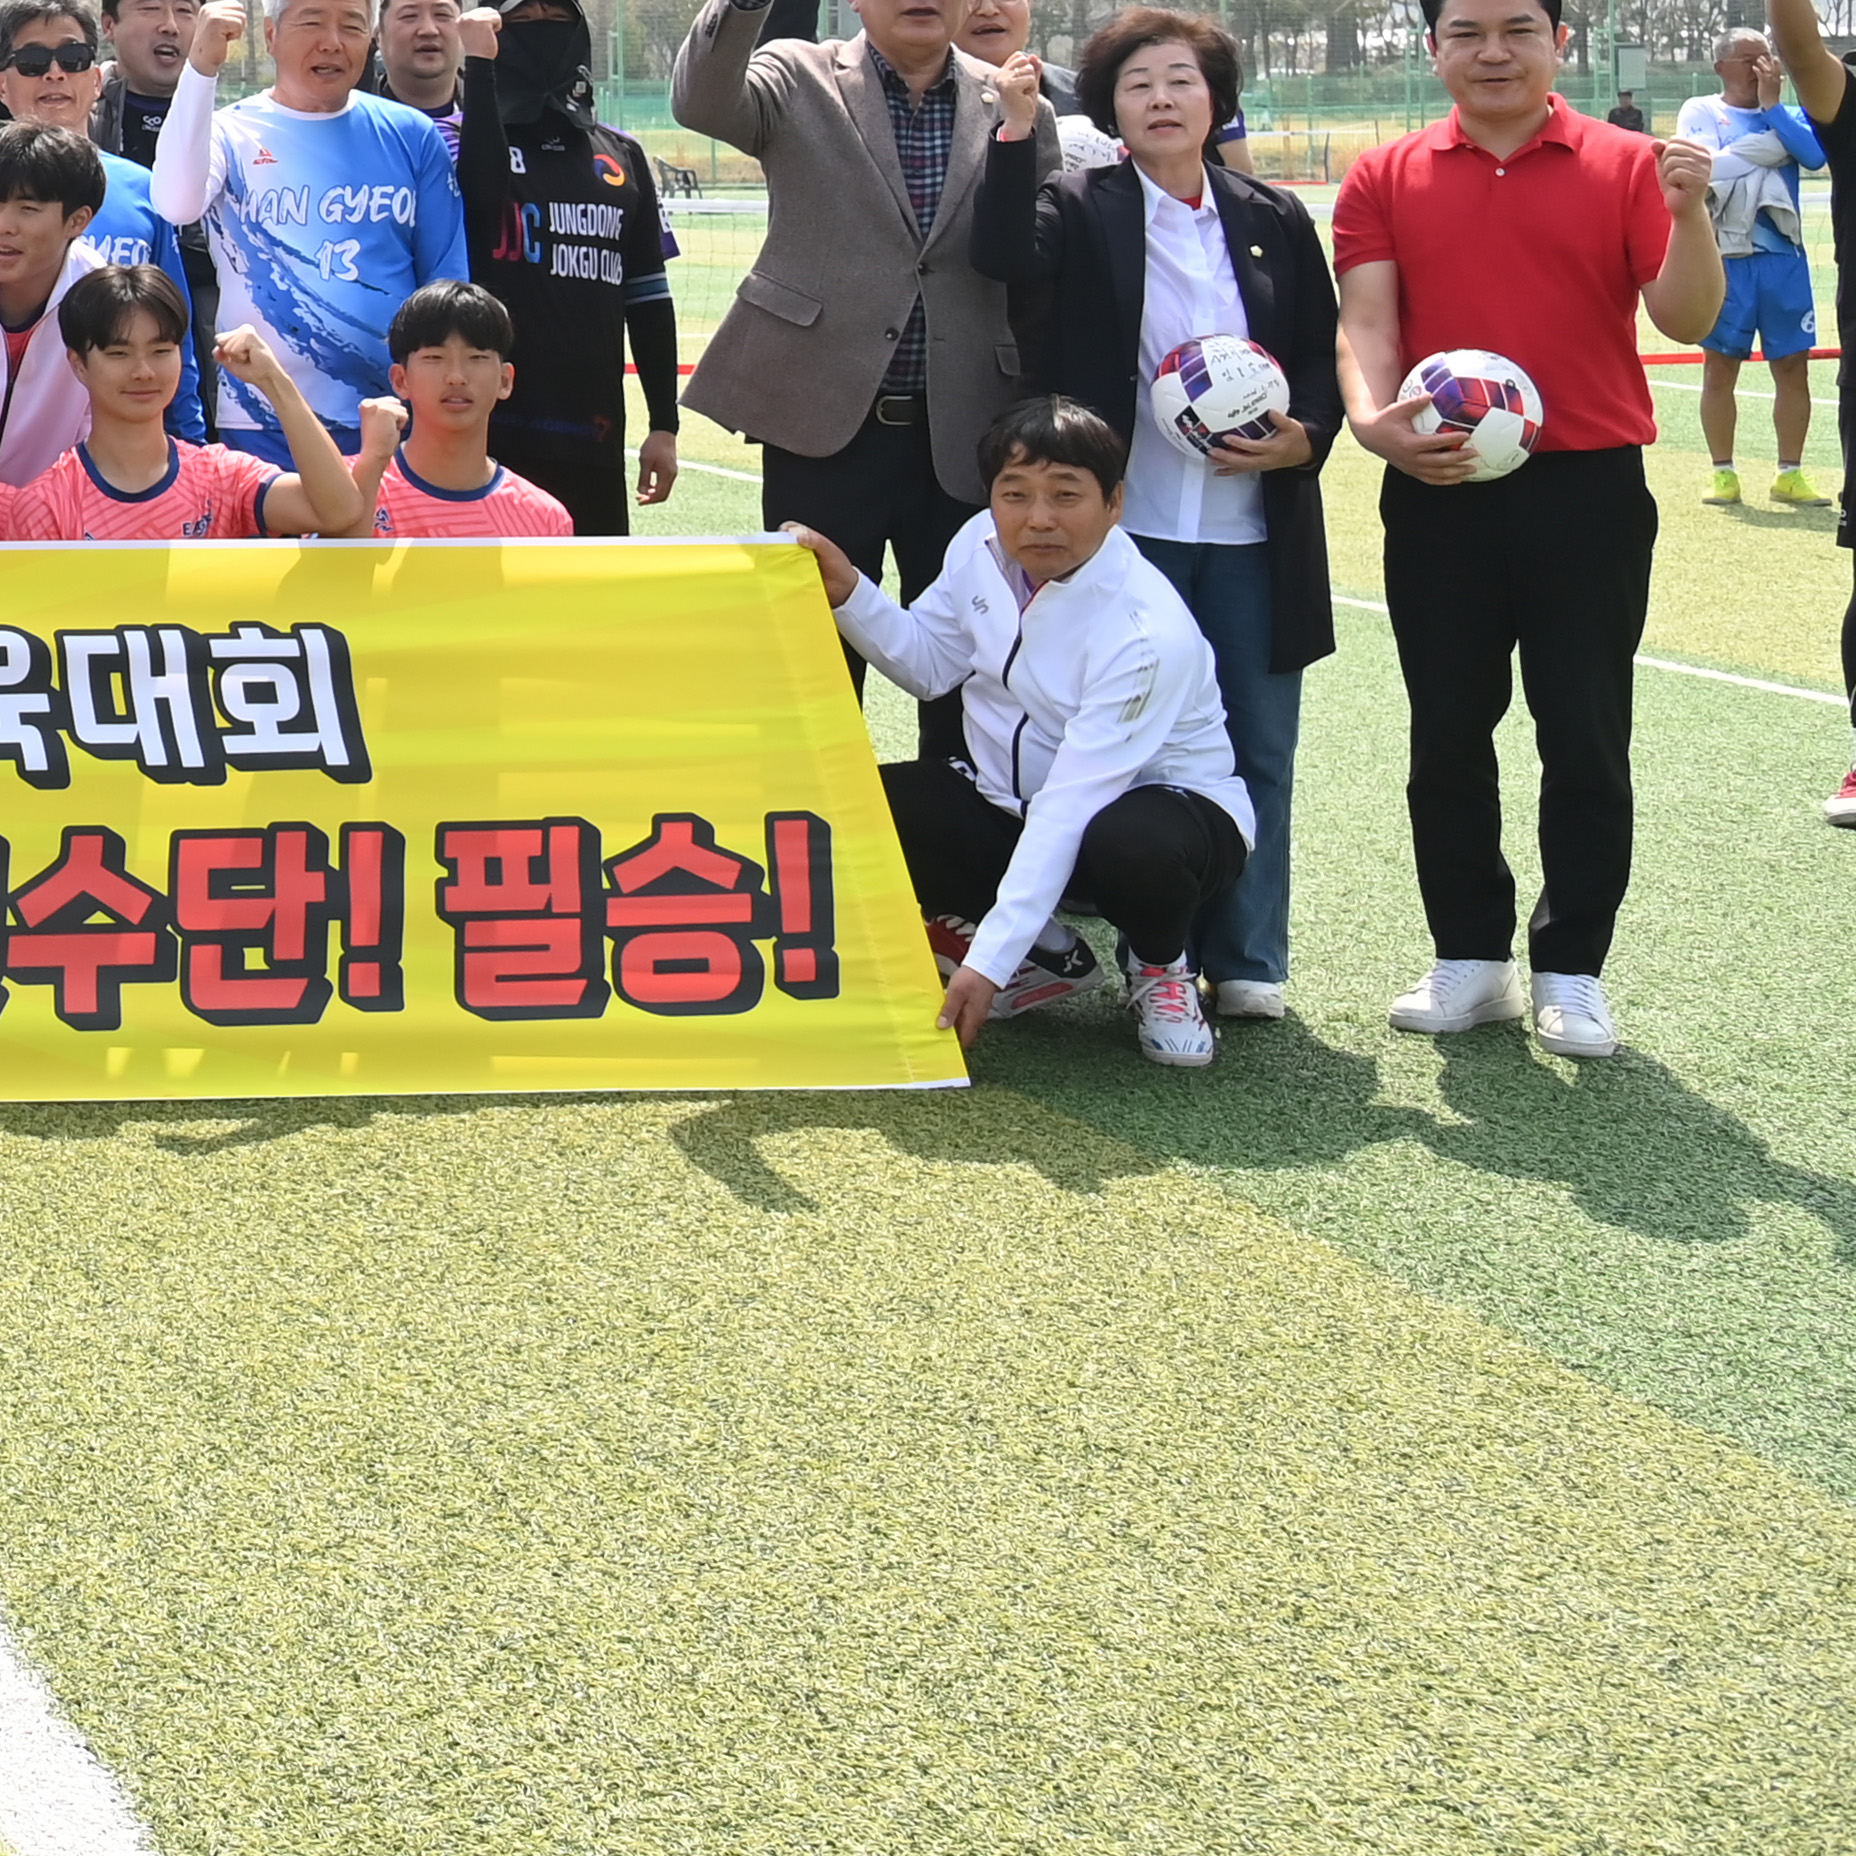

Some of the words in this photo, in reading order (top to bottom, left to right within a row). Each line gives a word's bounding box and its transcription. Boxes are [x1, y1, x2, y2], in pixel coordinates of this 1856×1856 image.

[240, 185, 310, 225] HAN
[549, 202, 624, 241] JUNGDONG
[317, 238, 362, 282] 13
[550, 243, 598, 281] JOKGU
[434, 810, 839, 1021] 필승!
